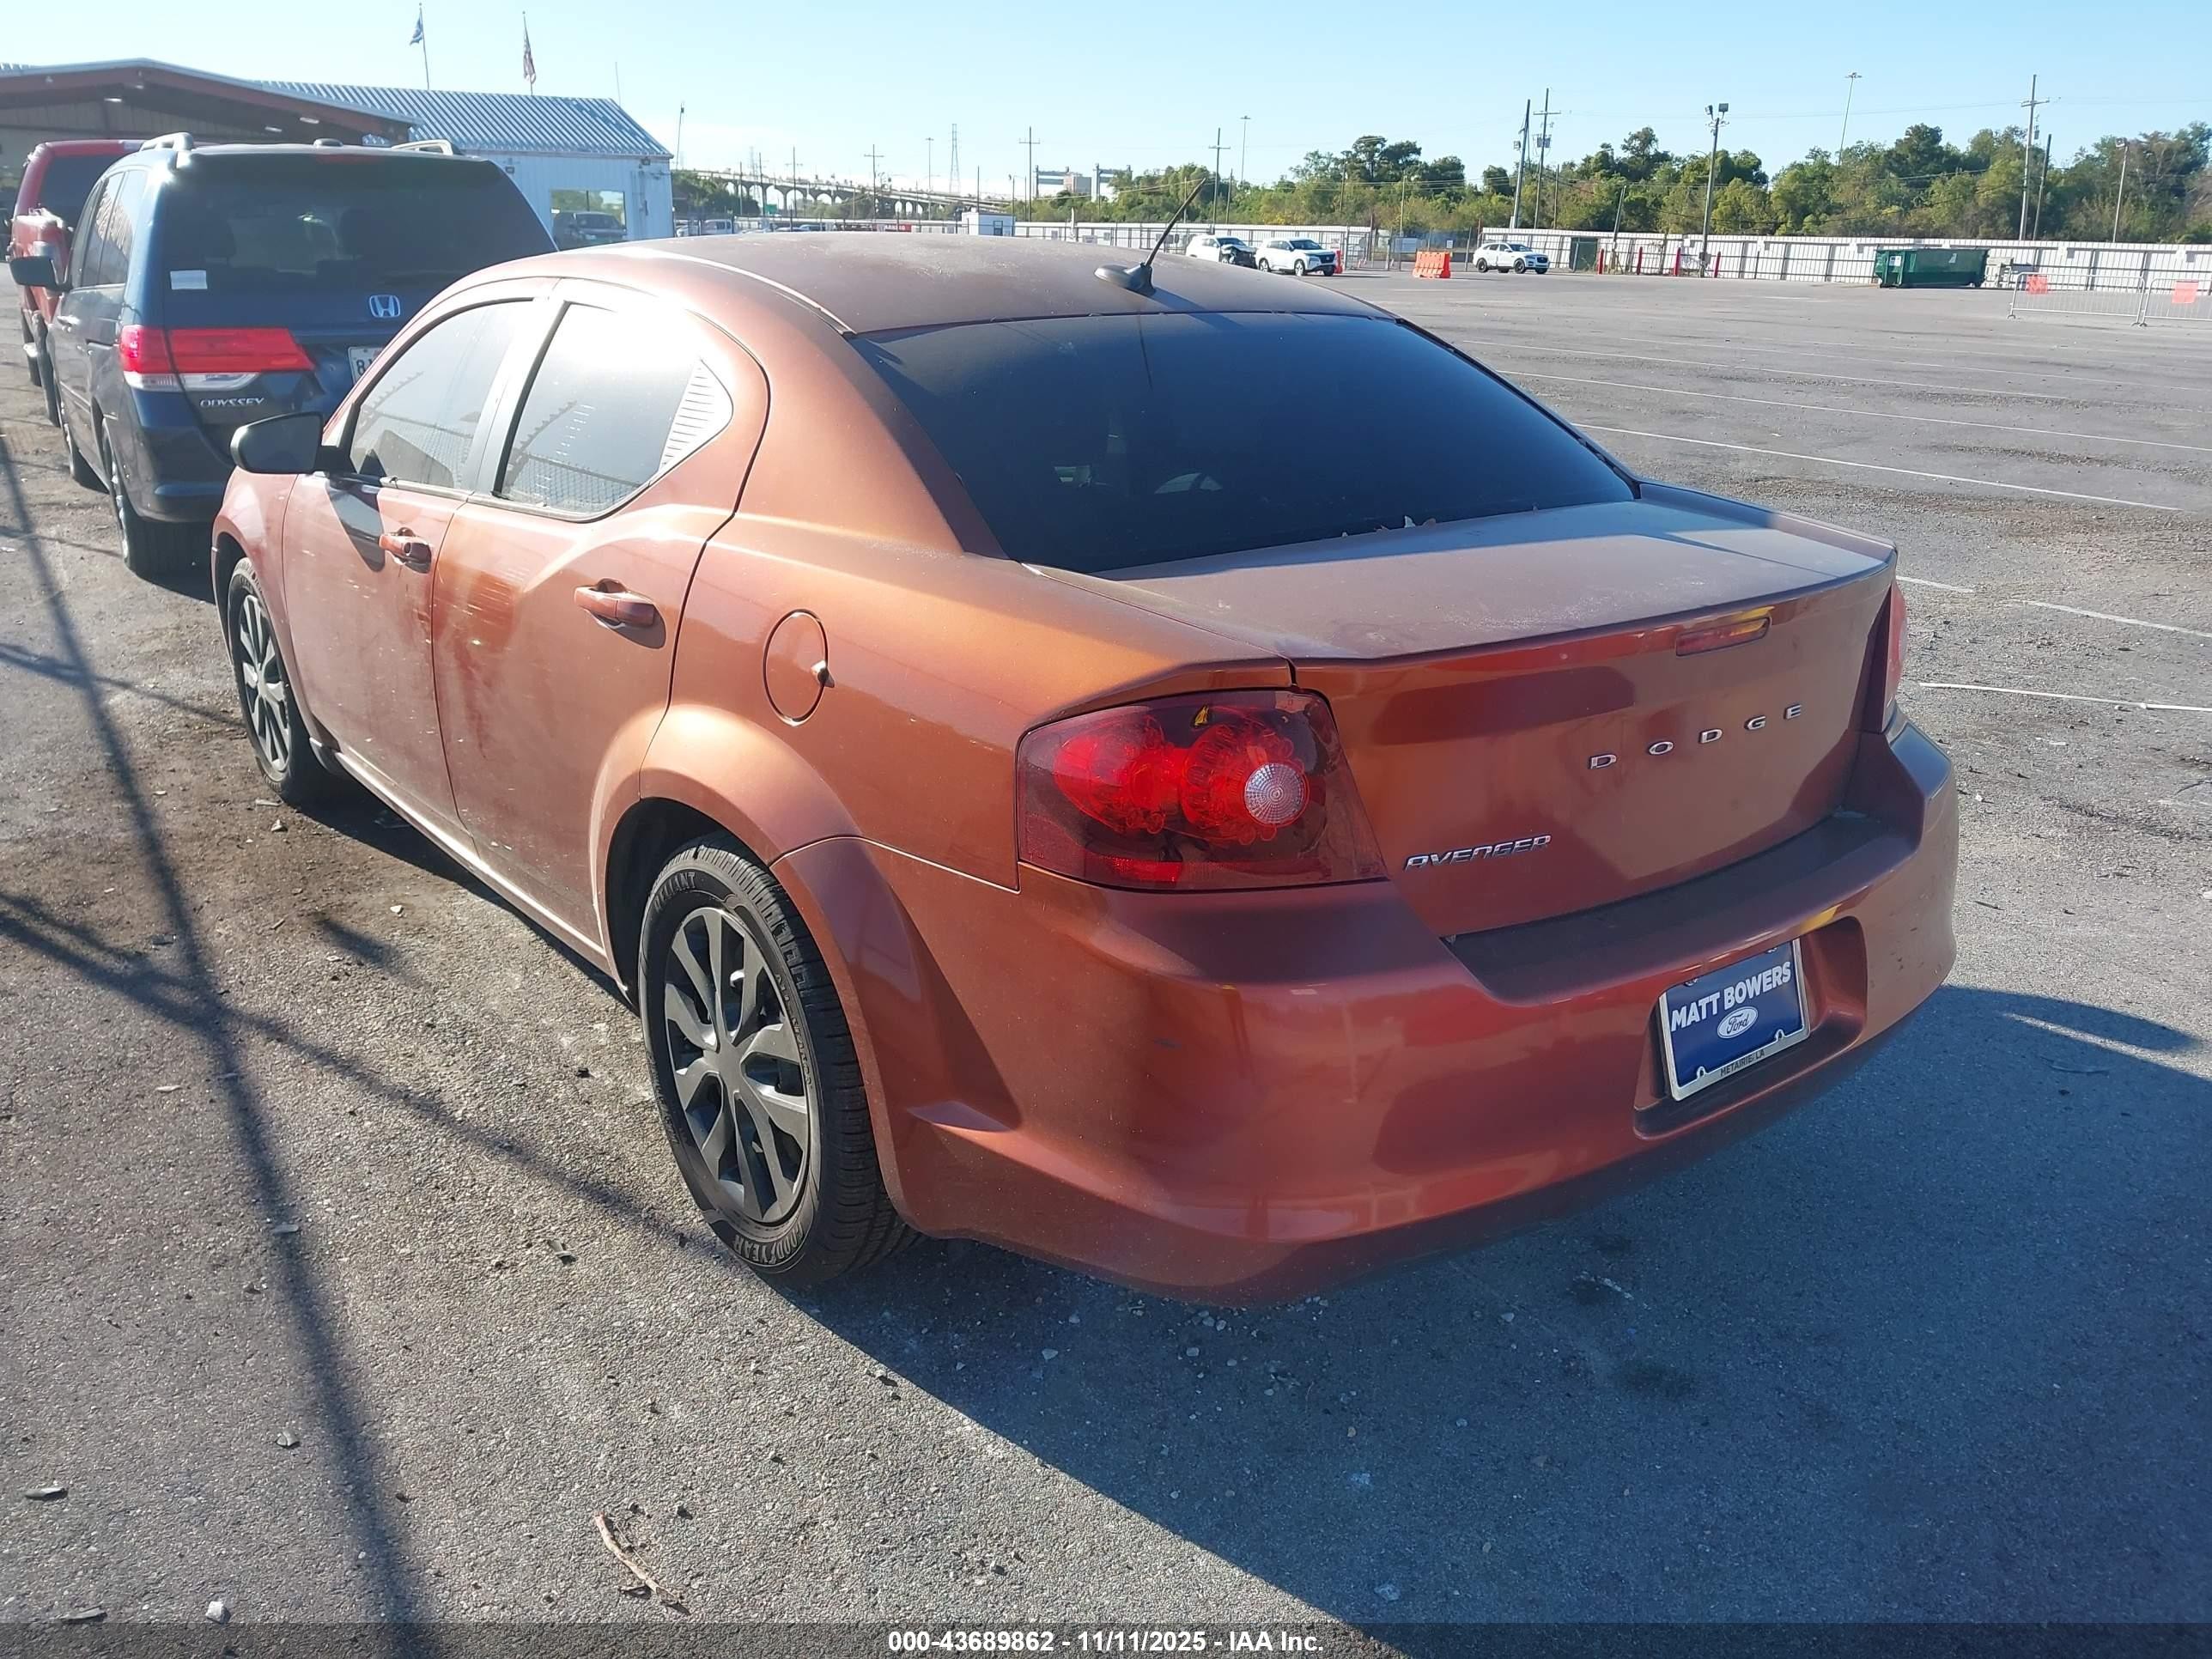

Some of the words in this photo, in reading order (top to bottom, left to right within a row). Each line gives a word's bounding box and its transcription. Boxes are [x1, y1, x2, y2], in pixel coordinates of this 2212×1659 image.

[199, 398, 264, 407] ODYSSEY
[1589, 704, 1802, 769] DODGE
[1403, 835, 1552, 872] AVENGER
[1671, 992, 1720, 1032] MATT
[1723, 961, 1791, 1010] BOWERS
[1726, 1013, 1751, 1035] Ford
[1755, 1048, 1765, 1060] LA
[733, 1219, 804, 1265] GOODYEAR
